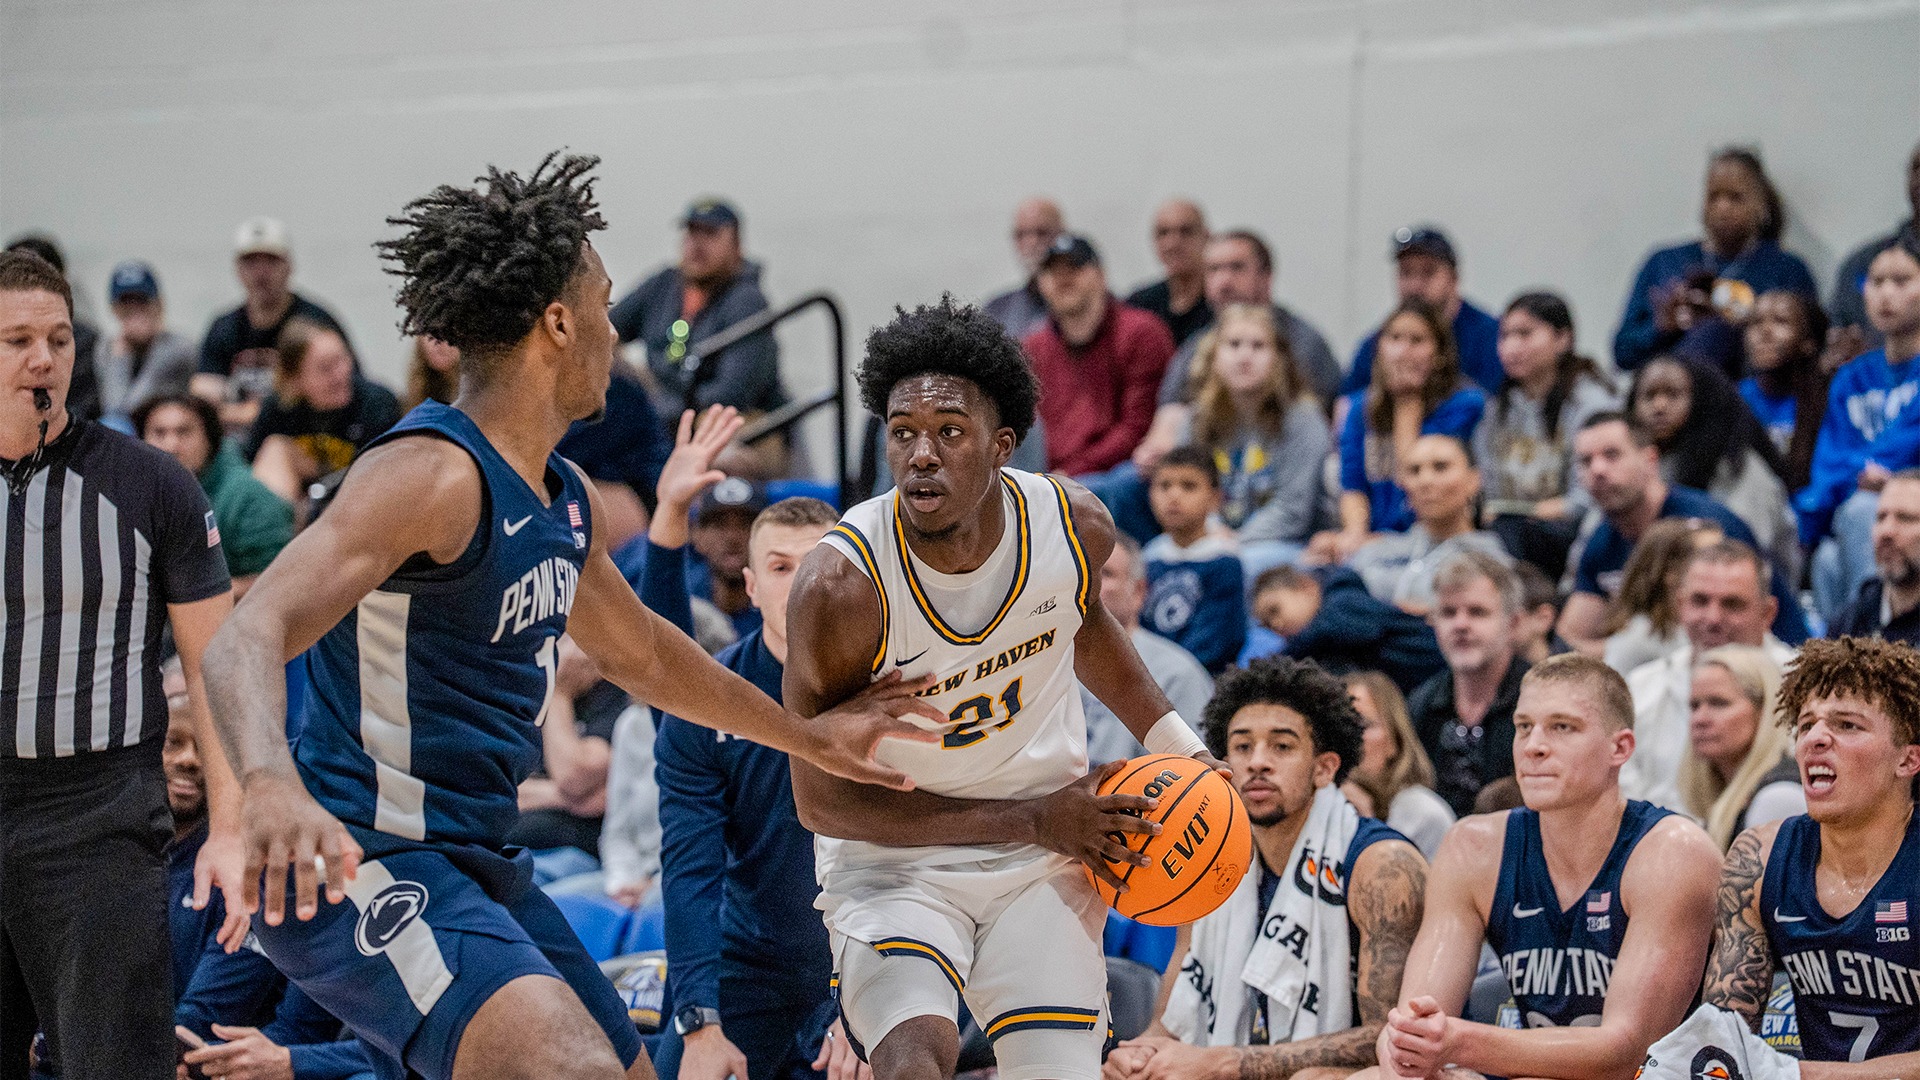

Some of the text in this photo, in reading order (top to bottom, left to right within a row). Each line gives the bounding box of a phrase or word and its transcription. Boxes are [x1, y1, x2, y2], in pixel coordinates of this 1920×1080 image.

[491, 558, 555, 643] PENN
[911, 628, 1056, 698] EW HAVEN
[941, 675, 1024, 750] 21
[1502, 947, 1565, 996] PENN
[1828, 1010, 1880, 1063] 7
